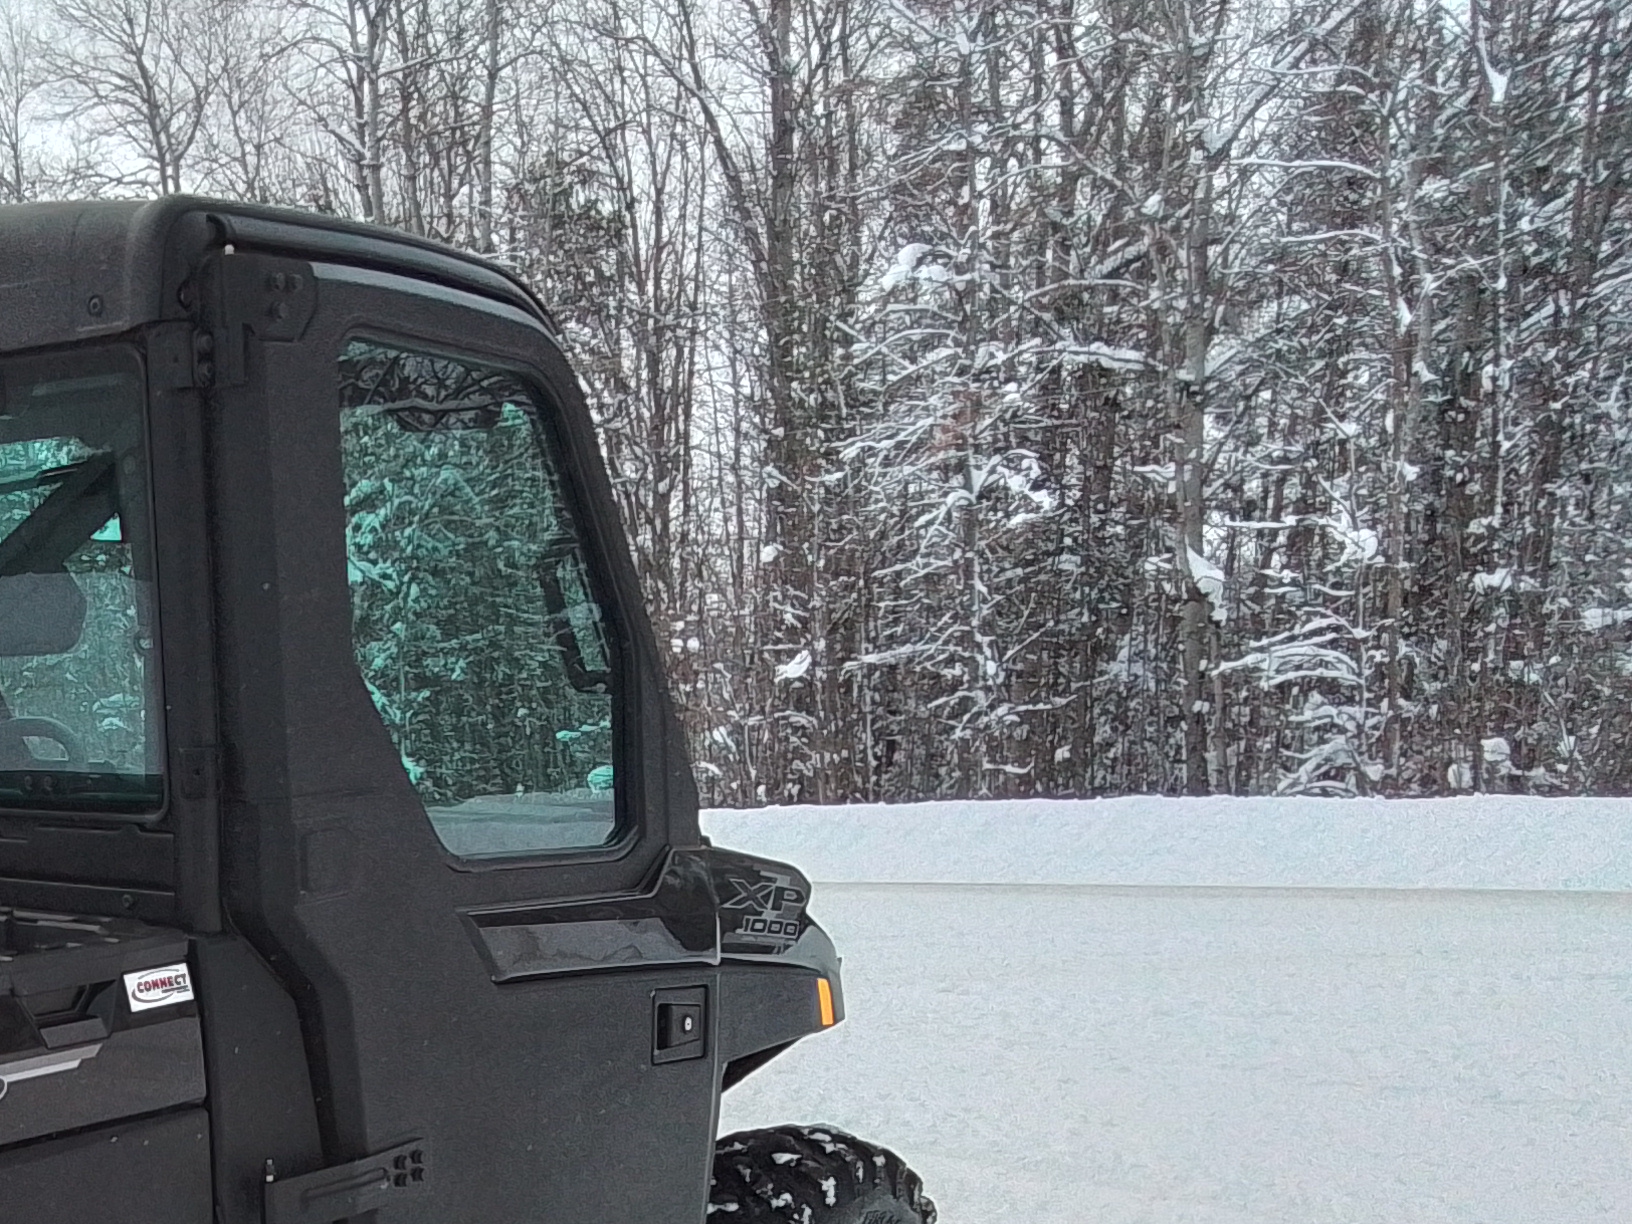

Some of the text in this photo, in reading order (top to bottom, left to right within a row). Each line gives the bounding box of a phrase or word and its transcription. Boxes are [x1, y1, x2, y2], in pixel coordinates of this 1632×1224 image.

[721, 878, 807, 913] XP
[742, 916, 799, 938] 1000
[136, 973, 187, 994] CONNECT
